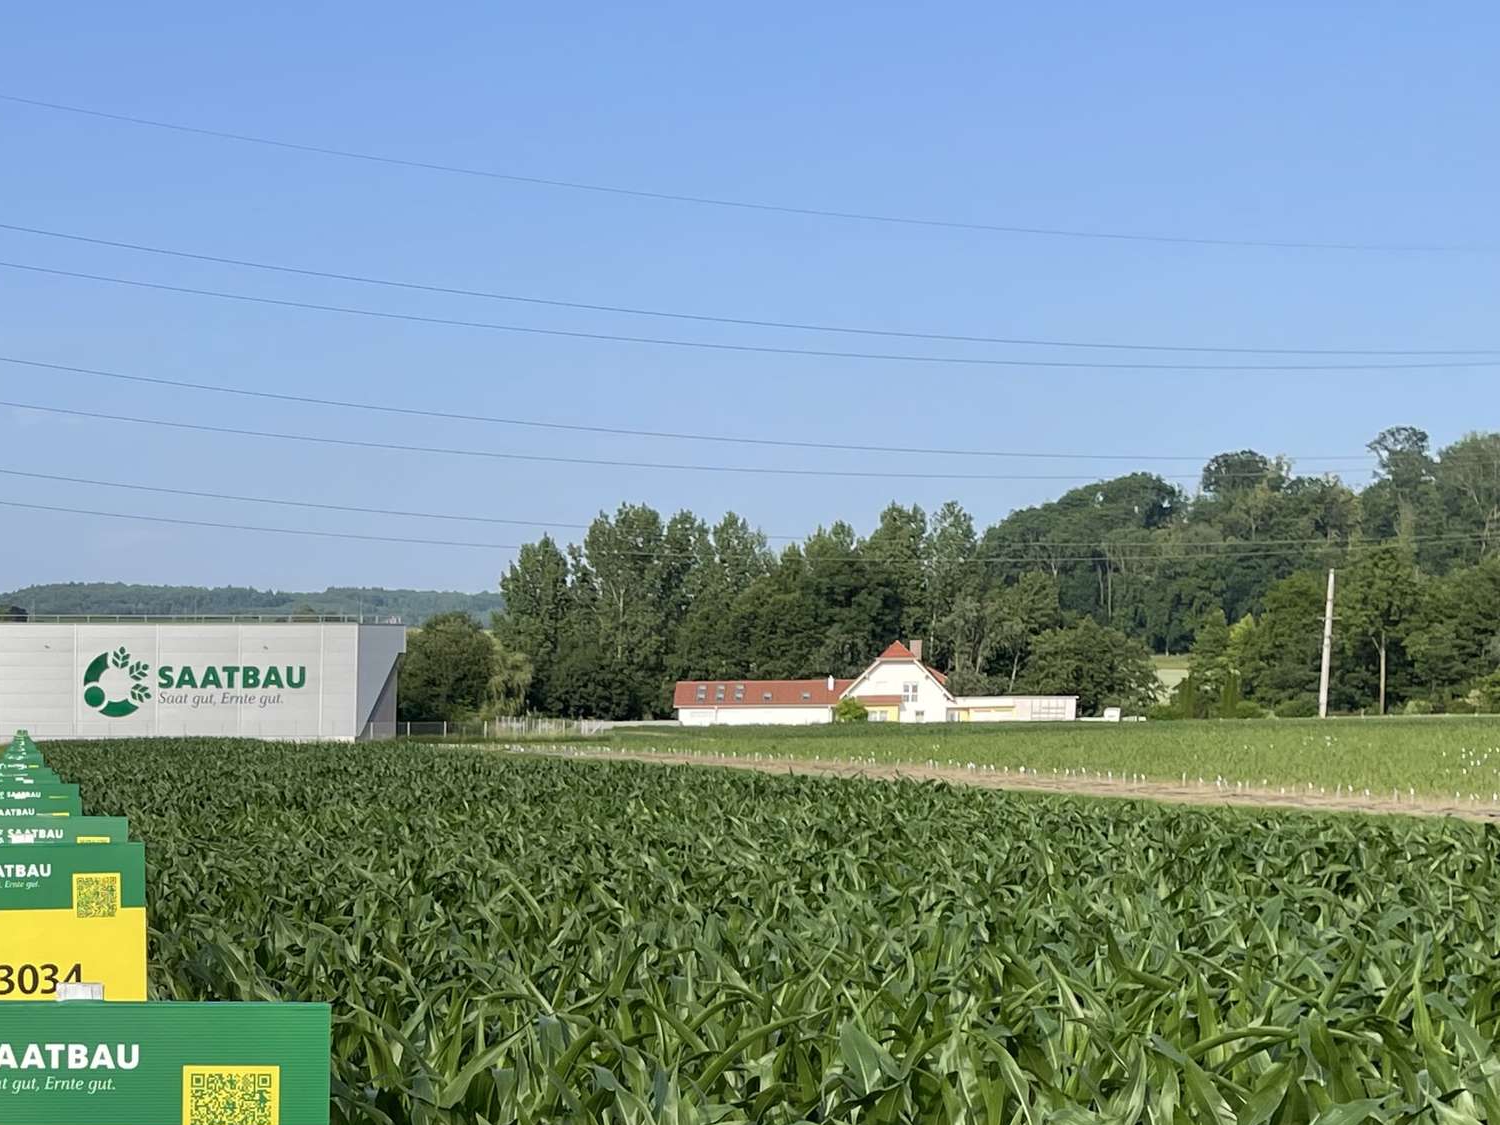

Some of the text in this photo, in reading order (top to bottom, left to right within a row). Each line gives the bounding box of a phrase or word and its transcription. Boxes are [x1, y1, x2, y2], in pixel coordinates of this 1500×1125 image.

[158, 666, 306, 689] SAATBAU
[158, 692, 285, 709] Saat gut, Ernte gut.
[12, 1077, 41, 1095] gut,
[44, 1076, 84, 1091] Ernte
[88, 1077, 116, 1095] gut.
